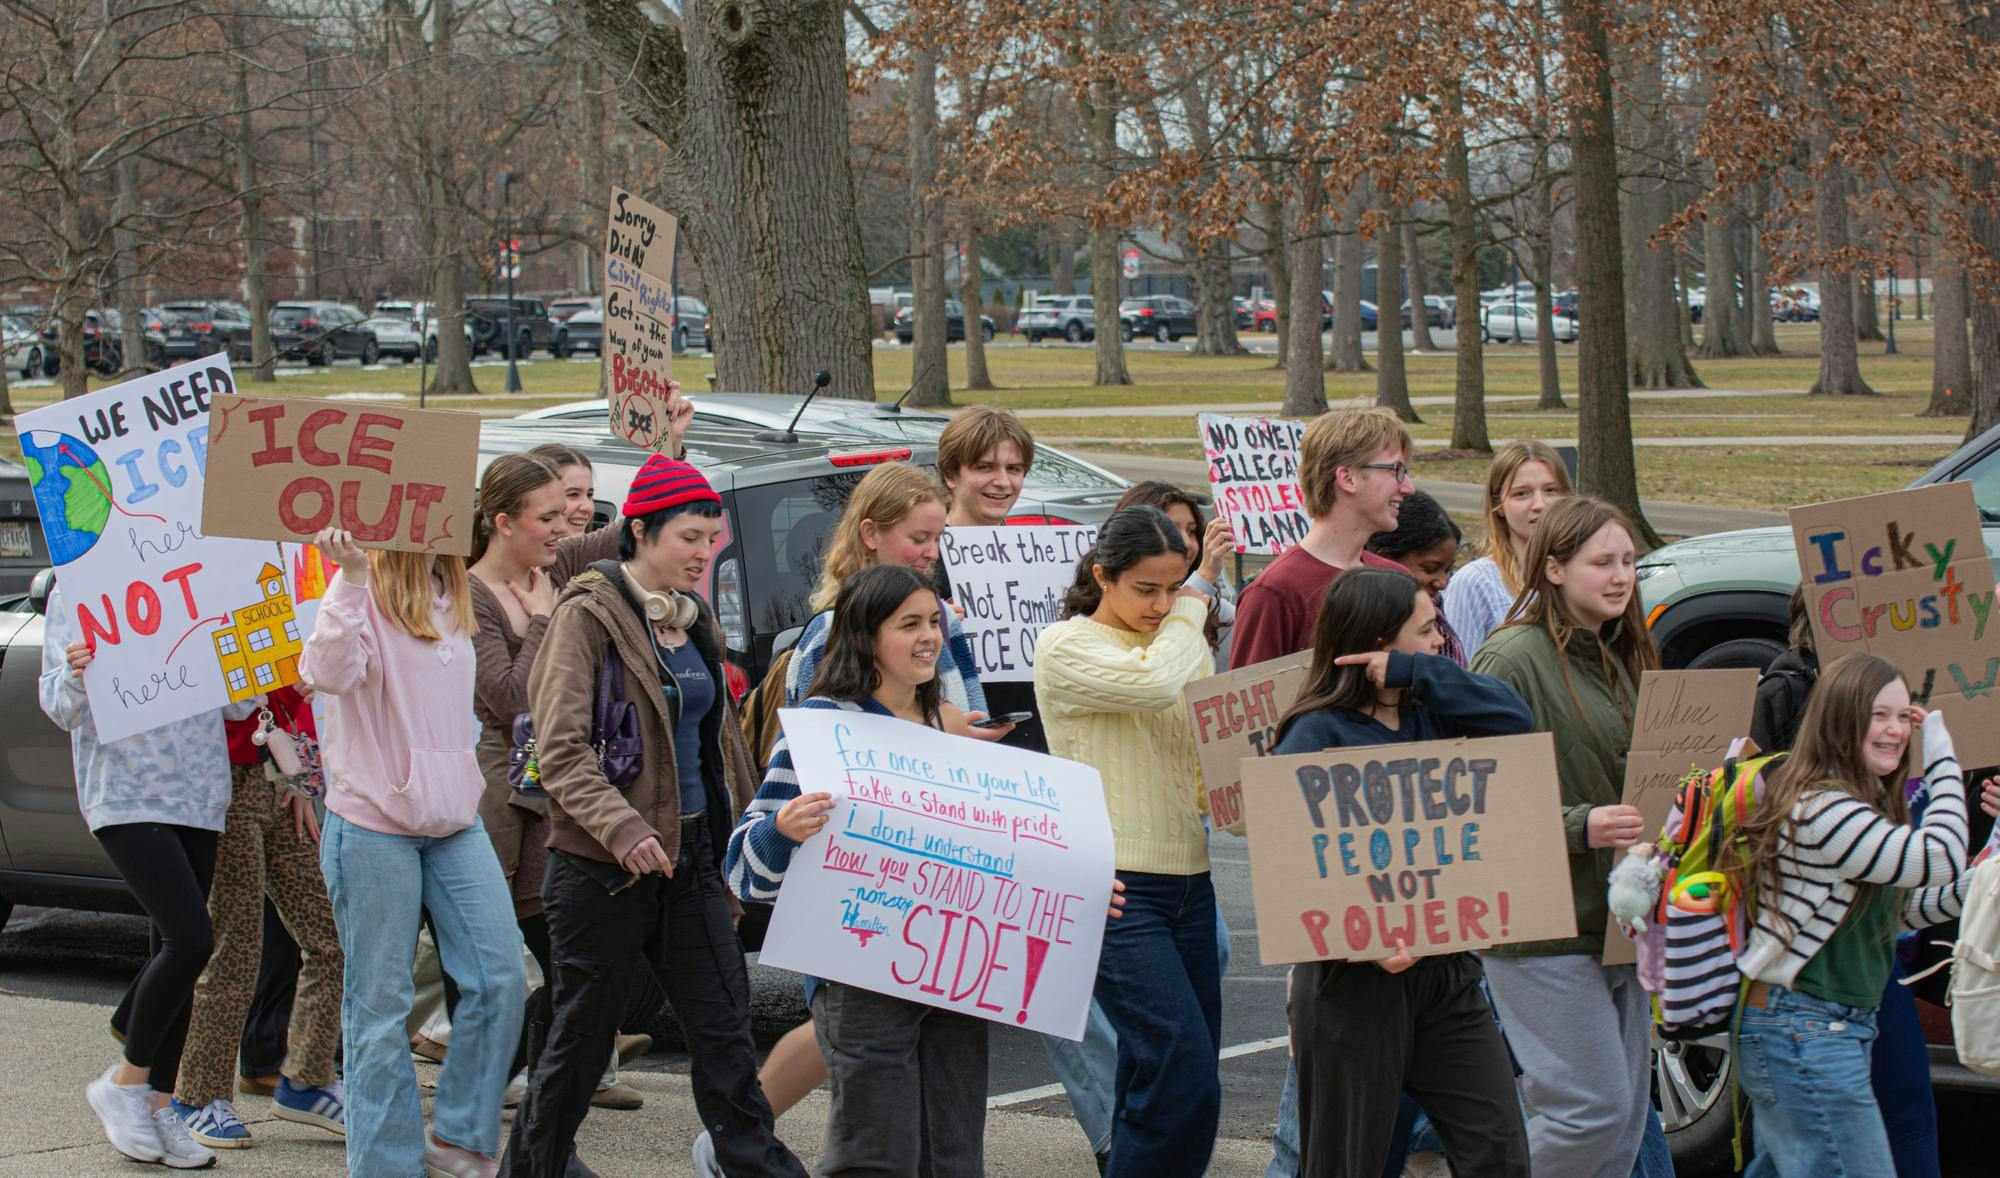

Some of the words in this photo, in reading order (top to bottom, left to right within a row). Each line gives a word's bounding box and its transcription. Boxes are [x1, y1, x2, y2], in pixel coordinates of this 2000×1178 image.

[609, 229, 632, 258] Did
[608, 259, 640, 291] Civil
[640, 284, 671, 315] Rights
[608, 292, 633, 320] Get
[635, 315, 644, 333] in
[649, 321, 666, 344] the
[609, 329, 626, 355] Way
[632, 338, 642, 352] of
[79, 402, 129, 445] WE
[142, 367, 233, 431] NEED
[629, 409, 652, 434] ICE
[248, 405, 404, 476] ICE
[1209, 423, 1238, 450] NO
[1245, 424, 1289, 450] ONE
[278, 476, 446, 544] OUT
[1242, 512, 1310, 547] LAND
[129, 521, 207, 562] her
[943, 530, 1011, 566] Break
[1017, 532, 1056, 564] the
[1809, 521, 1956, 584] Icky
[76, 562, 203, 653] NOT
[242, 599, 291, 625] SCHOOLS
[957, 582, 1002, 620] Not
[1005, 581, 1066, 624] Familie
[1819, 567, 1994, 642] Crusty
[964, 628, 1015, 673] ICE
[112, 663, 199, 710] here
[1194, 680, 1279, 744] FIGHT
[835, 724, 877, 768] for
[889, 753, 935, 780] once
[948, 764, 970, 786] in
[978, 774, 1018, 800] your
[1024, 769, 1060, 807] life
[1296, 756, 1497, 828] PROTECT
[843, 772, 894, 805] take
[902, 787, 915, 806] a
[1012, 814, 1062, 842] pride
[847, 803, 857, 828] i
[871, 810, 915, 846] dont
[924, 832, 1015, 873] understand
[1312, 823, 1481, 878] PEOPLE
[825, 835, 867, 872] how
[880, 859, 909, 888] you
[913, 861, 985, 914] STAND
[992, 876, 1023, 921] TO
[1027, 887, 1085, 945] THE
[1367, 869, 1441, 902] NOT
[840, 899, 891, 936] Hamilton
[1301, 891, 1510, 956] POWER!
[891, 904, 1050, 1024] SIDE!
